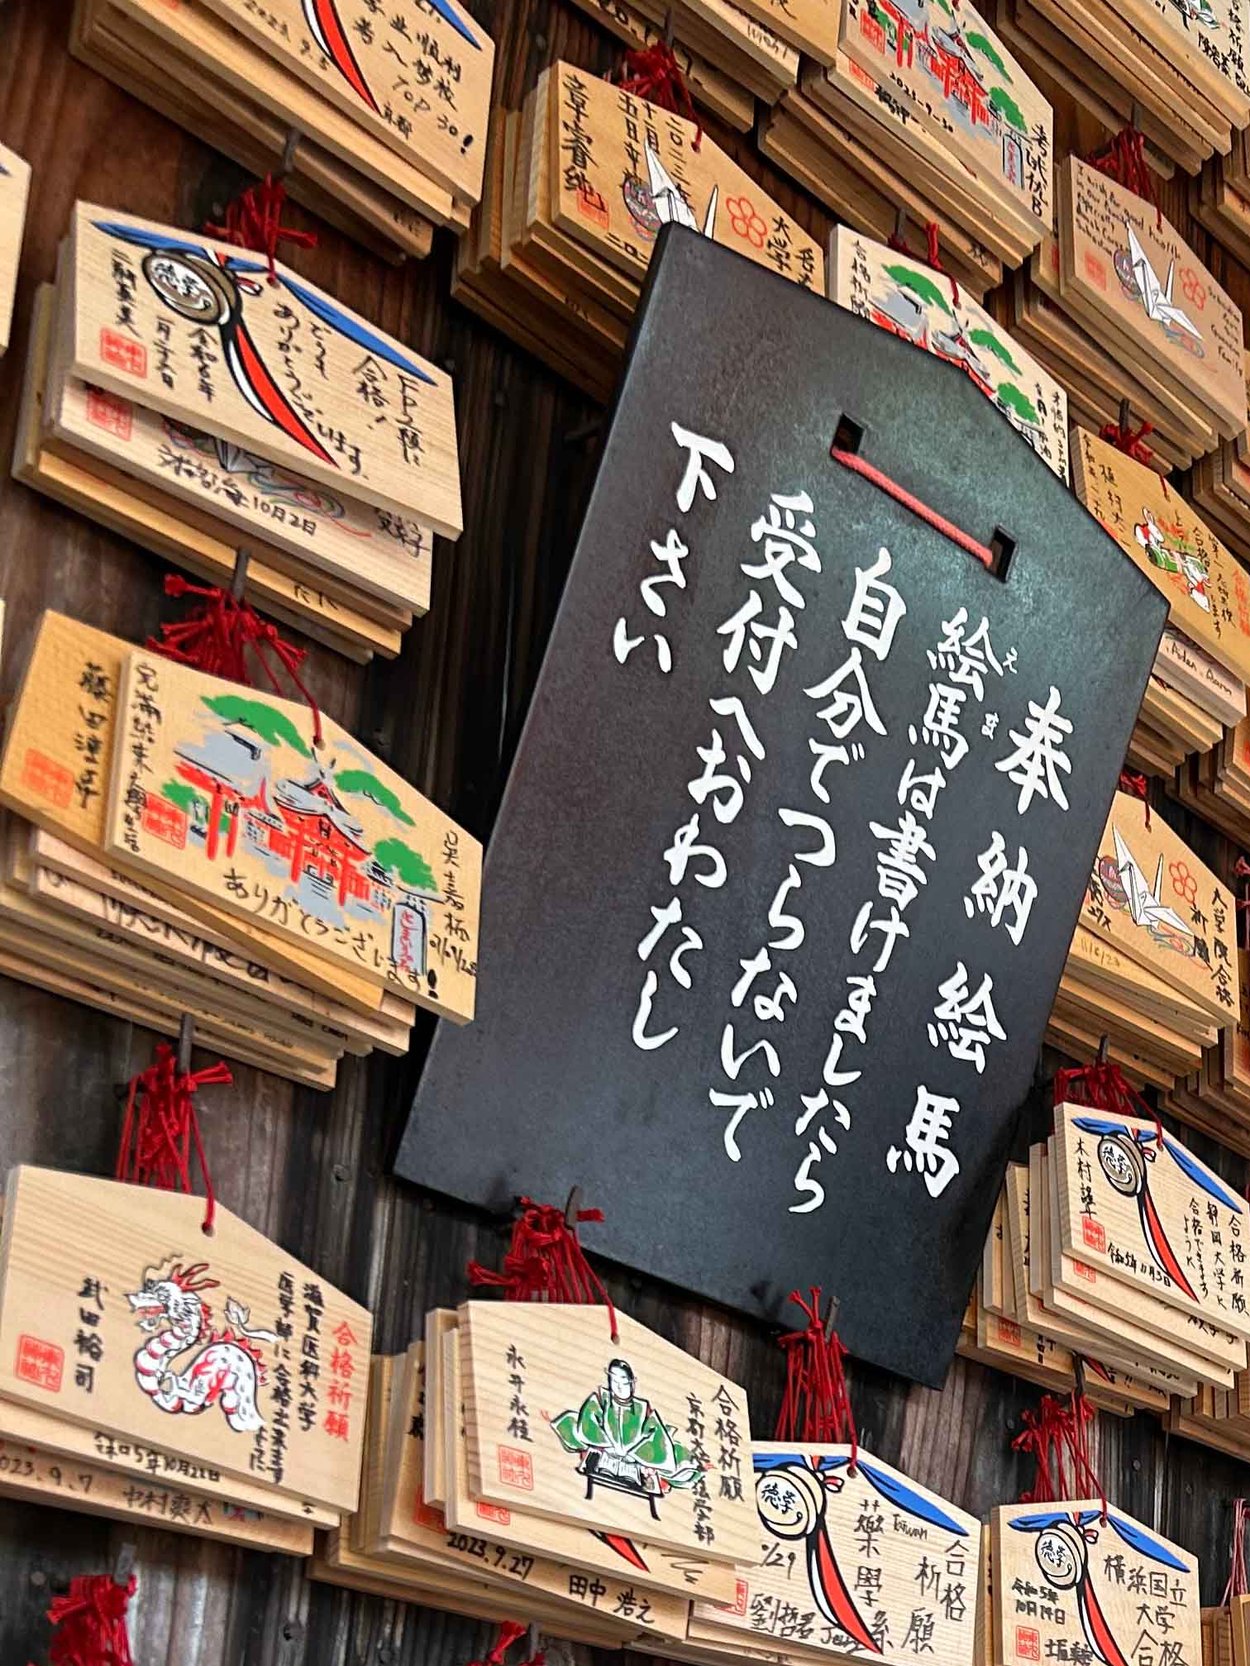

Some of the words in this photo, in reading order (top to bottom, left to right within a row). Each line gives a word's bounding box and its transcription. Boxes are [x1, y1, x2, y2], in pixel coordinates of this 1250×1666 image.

[613, 421, 735, 674] 下さい
[632, 489, 822, 1050] 受付へおわたし
[708, 546, 907, 1162] 自分でつらないで
[788, 606, 1004, 1214] 絵馬は書けましたら
[886, 686, 1074, 1198] 奉納絵馬
[1228, 1214, 1250, 1317] 合格祈願
[298, 1282, 326, 1433] 滋賀医科大学
[323, 1320, 359, 1443] 合格祈願
[712, 1384, 745, 1503] 合格祈願
[1103, 1554, 1188, 1608] 横浜国立
[1136, 1602, 1176, 1635] 大学
